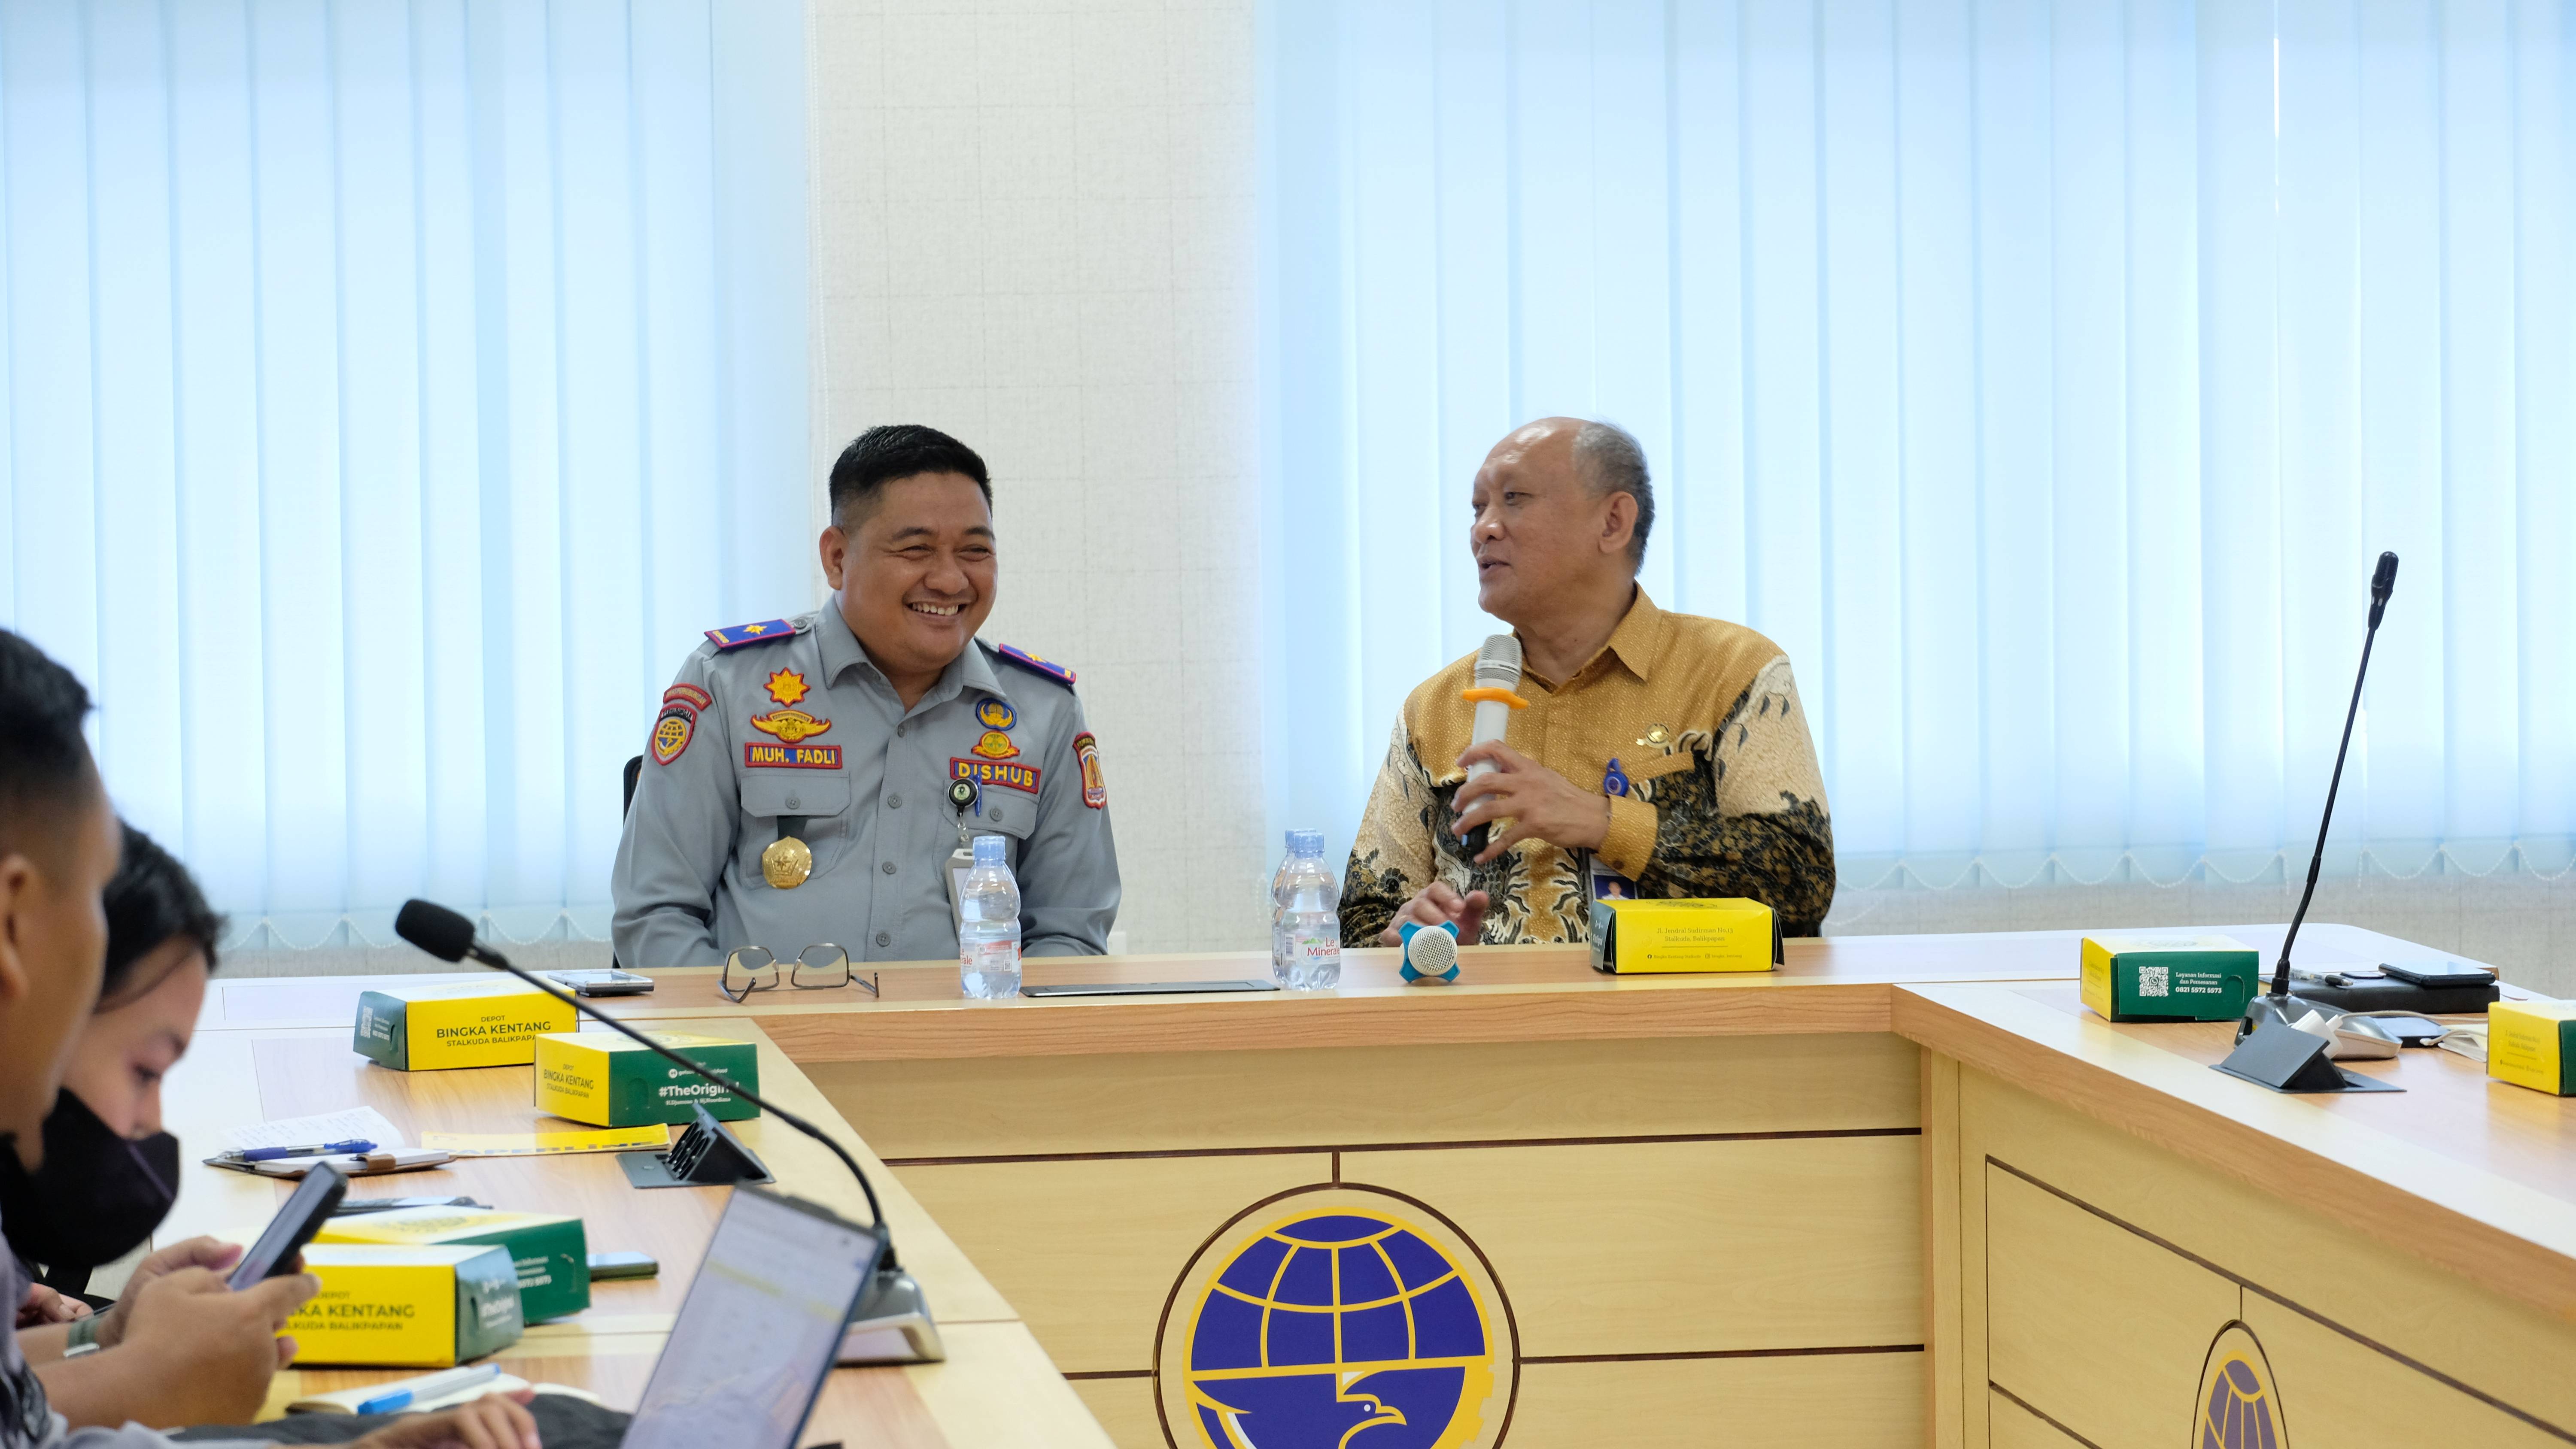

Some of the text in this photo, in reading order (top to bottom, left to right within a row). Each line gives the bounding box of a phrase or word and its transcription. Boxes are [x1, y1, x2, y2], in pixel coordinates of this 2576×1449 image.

[752, 746, 835, 764] MUH. FADLI
[958, 762, 1033, 787] DISHUB
[1326, 937, 1334, 947] Le
[1307, 945, 1340, 956] Minerale
[437, 1021, 551, 1038] BINGKA KENTANG
[492, 1034, 536, 1044] BALIKPAPA
[544, 1069, 594, 1090] BINGKA KENTANG
[328, 1303, 415, 1318] KENTANG
